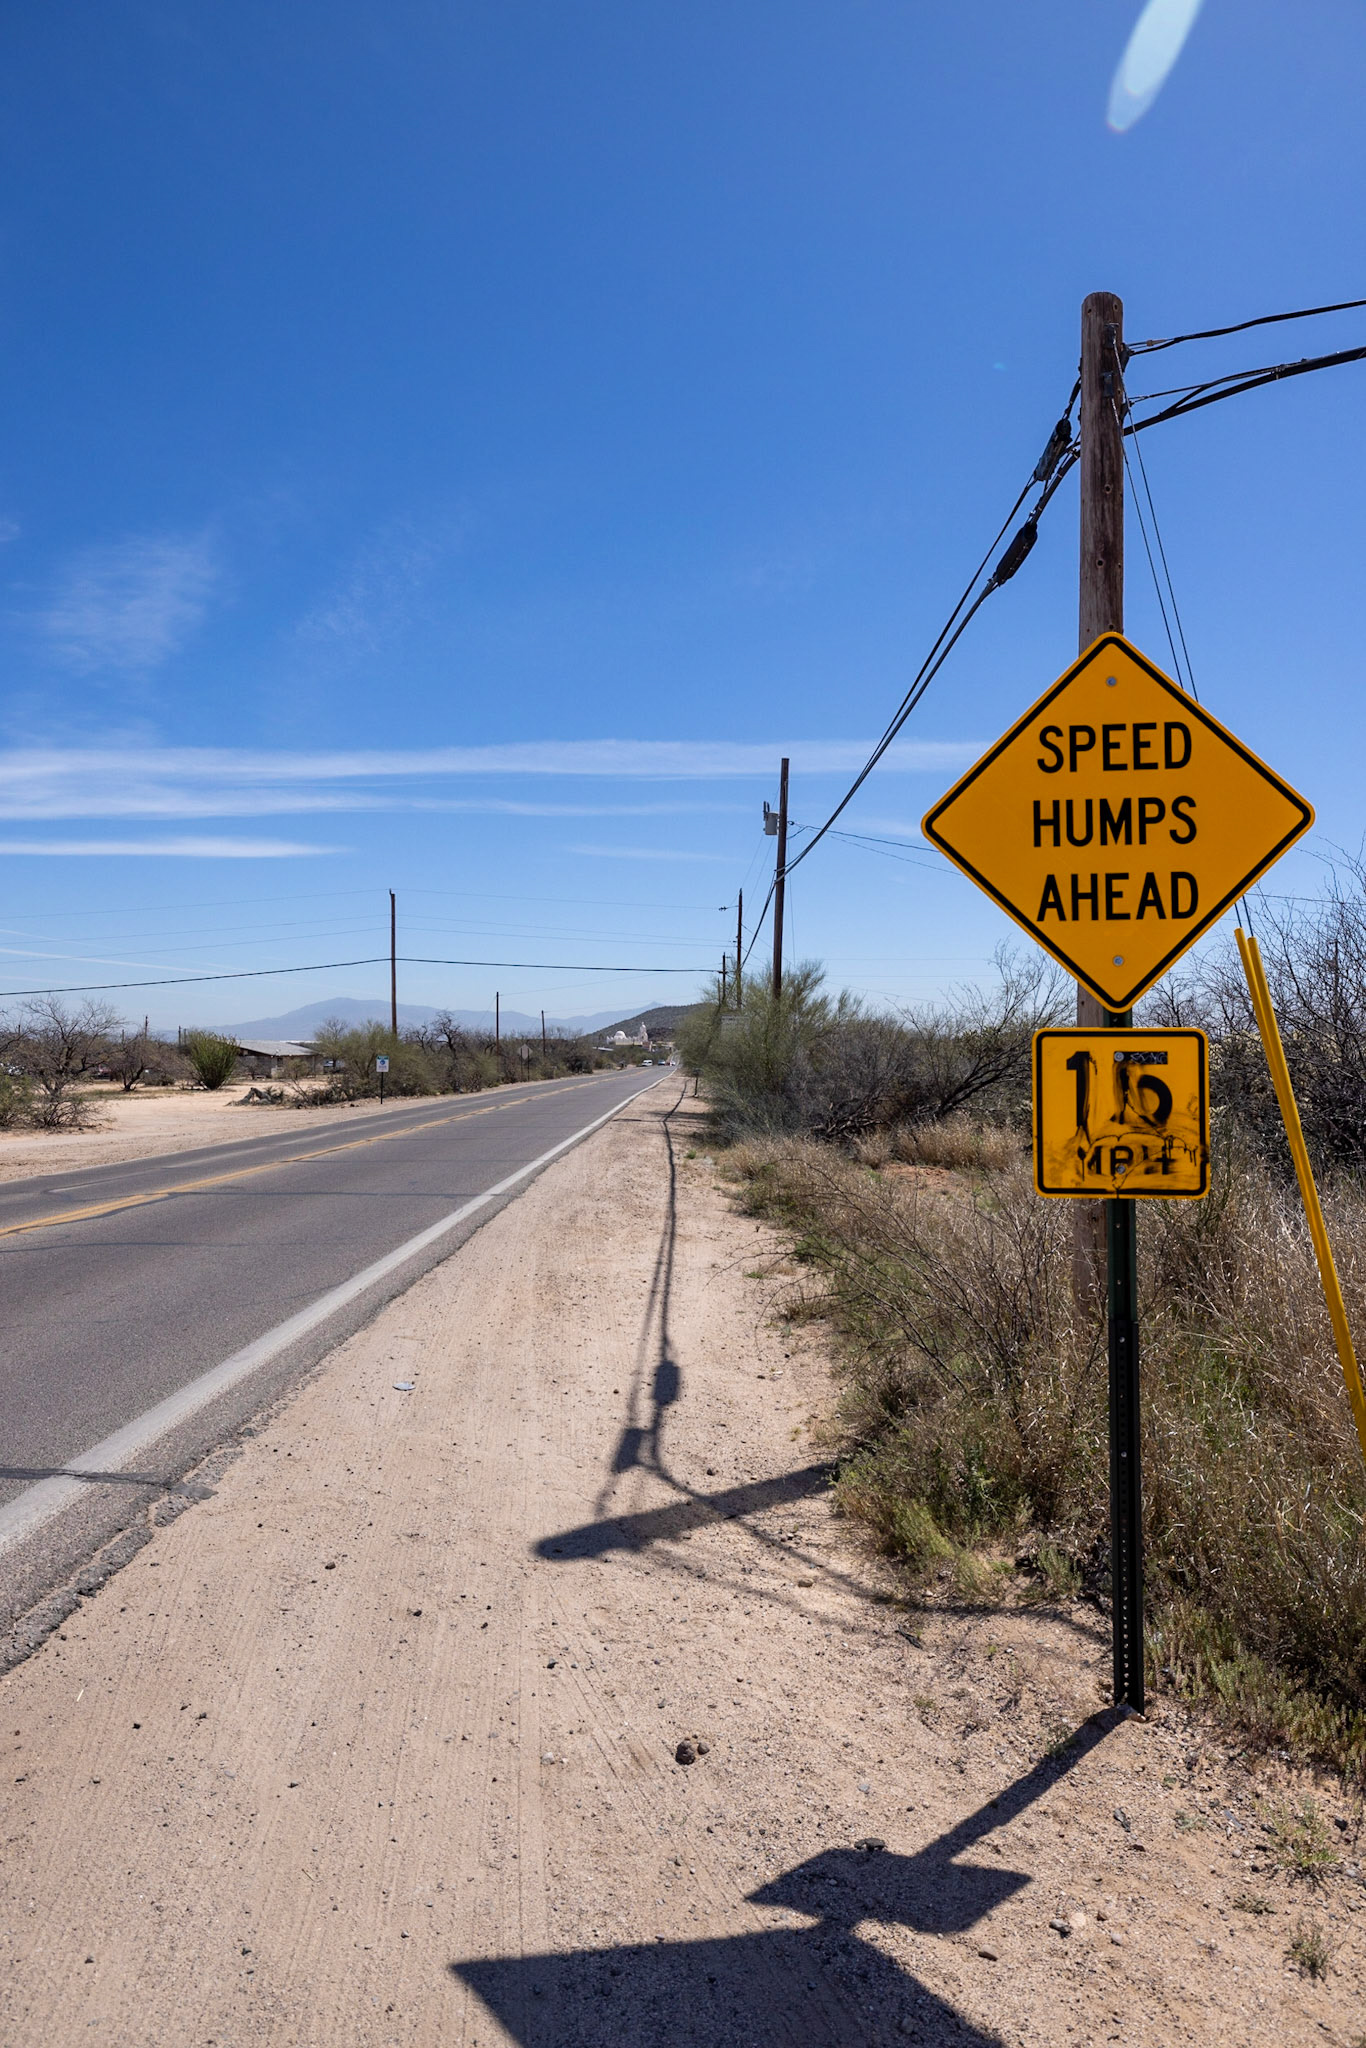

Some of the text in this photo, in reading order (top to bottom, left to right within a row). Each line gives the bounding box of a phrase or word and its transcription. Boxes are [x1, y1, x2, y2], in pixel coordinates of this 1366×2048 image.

[1037, 721, 1192, 774] SPEED
[1033, 795, 1197, 847] HUMPS
[1036, 871, 1199, 922] AHEAD
[1066, 1051, 1173, 1127] 15
